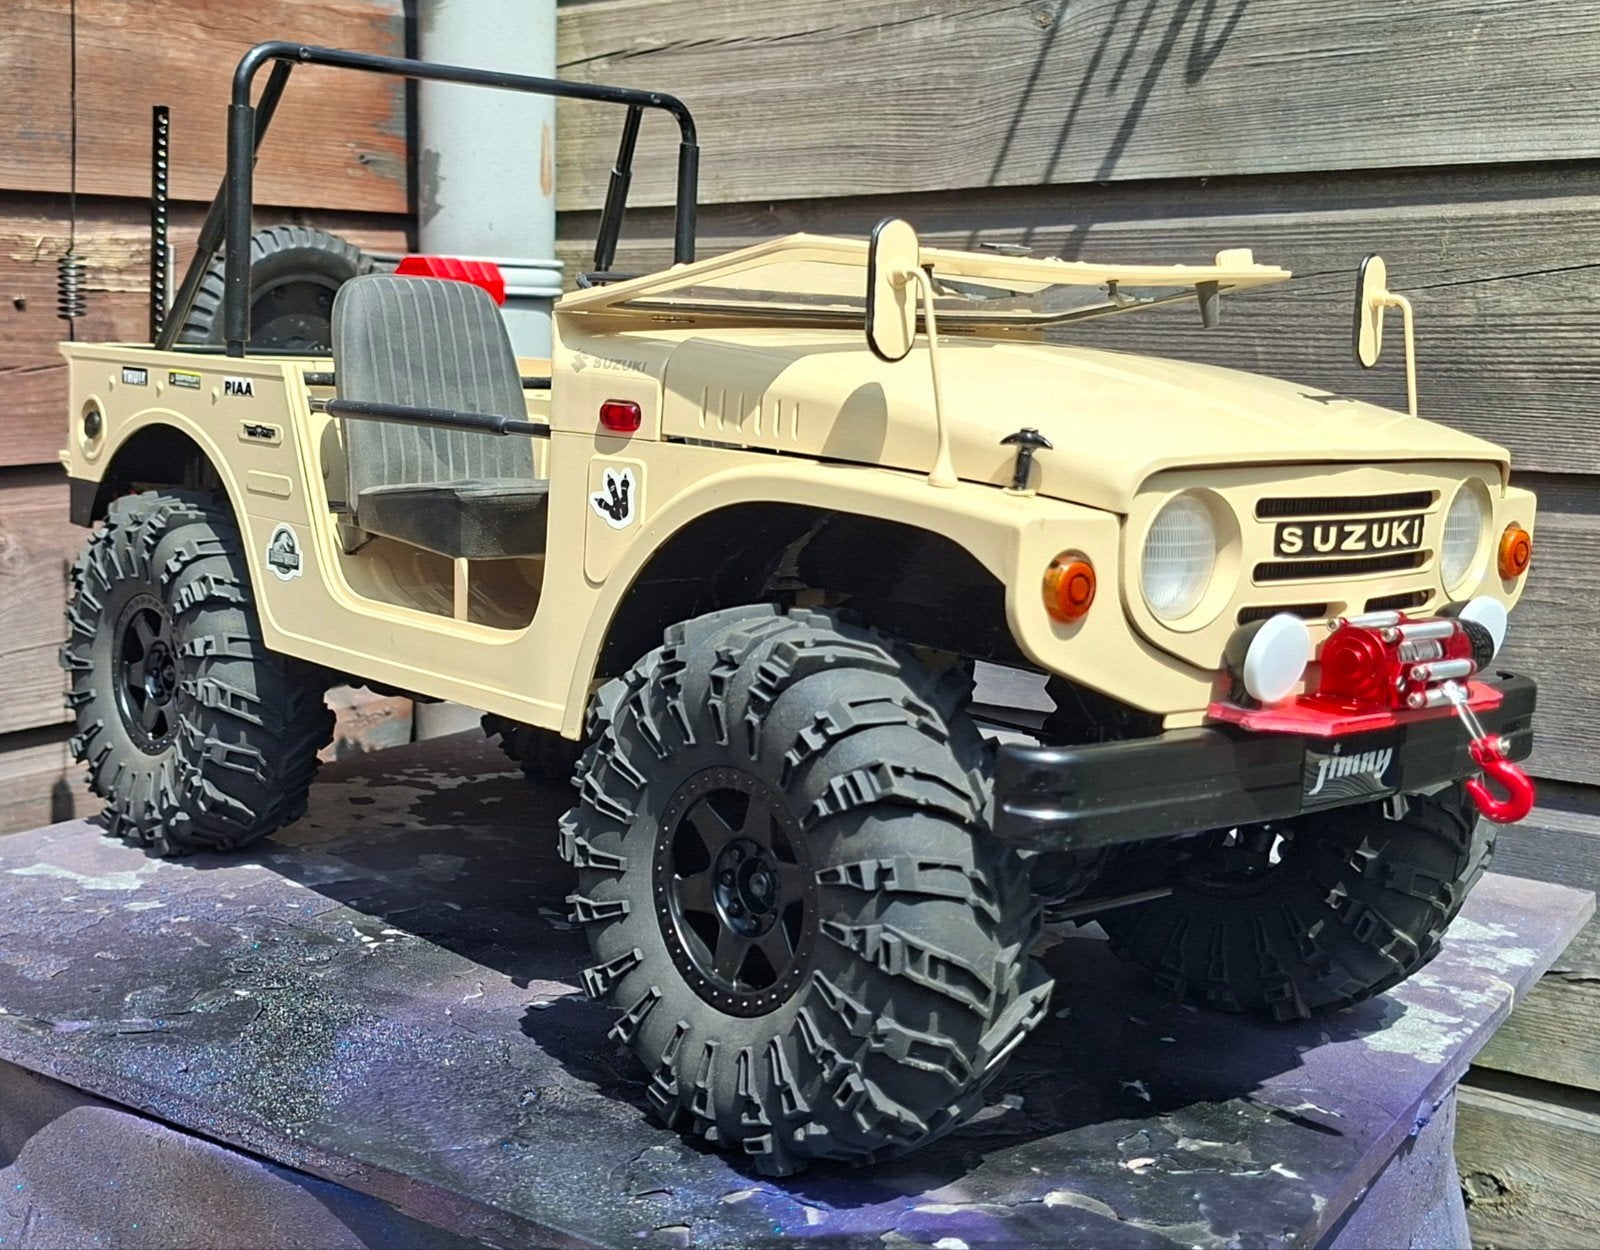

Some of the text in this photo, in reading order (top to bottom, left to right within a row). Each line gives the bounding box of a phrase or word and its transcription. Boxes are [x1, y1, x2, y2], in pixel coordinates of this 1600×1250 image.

[593, 356, 647, 374] SUZUKI
[224, 380, 253, 397] PIAA
[1279, 519, 1421, 554] SUZUKI
